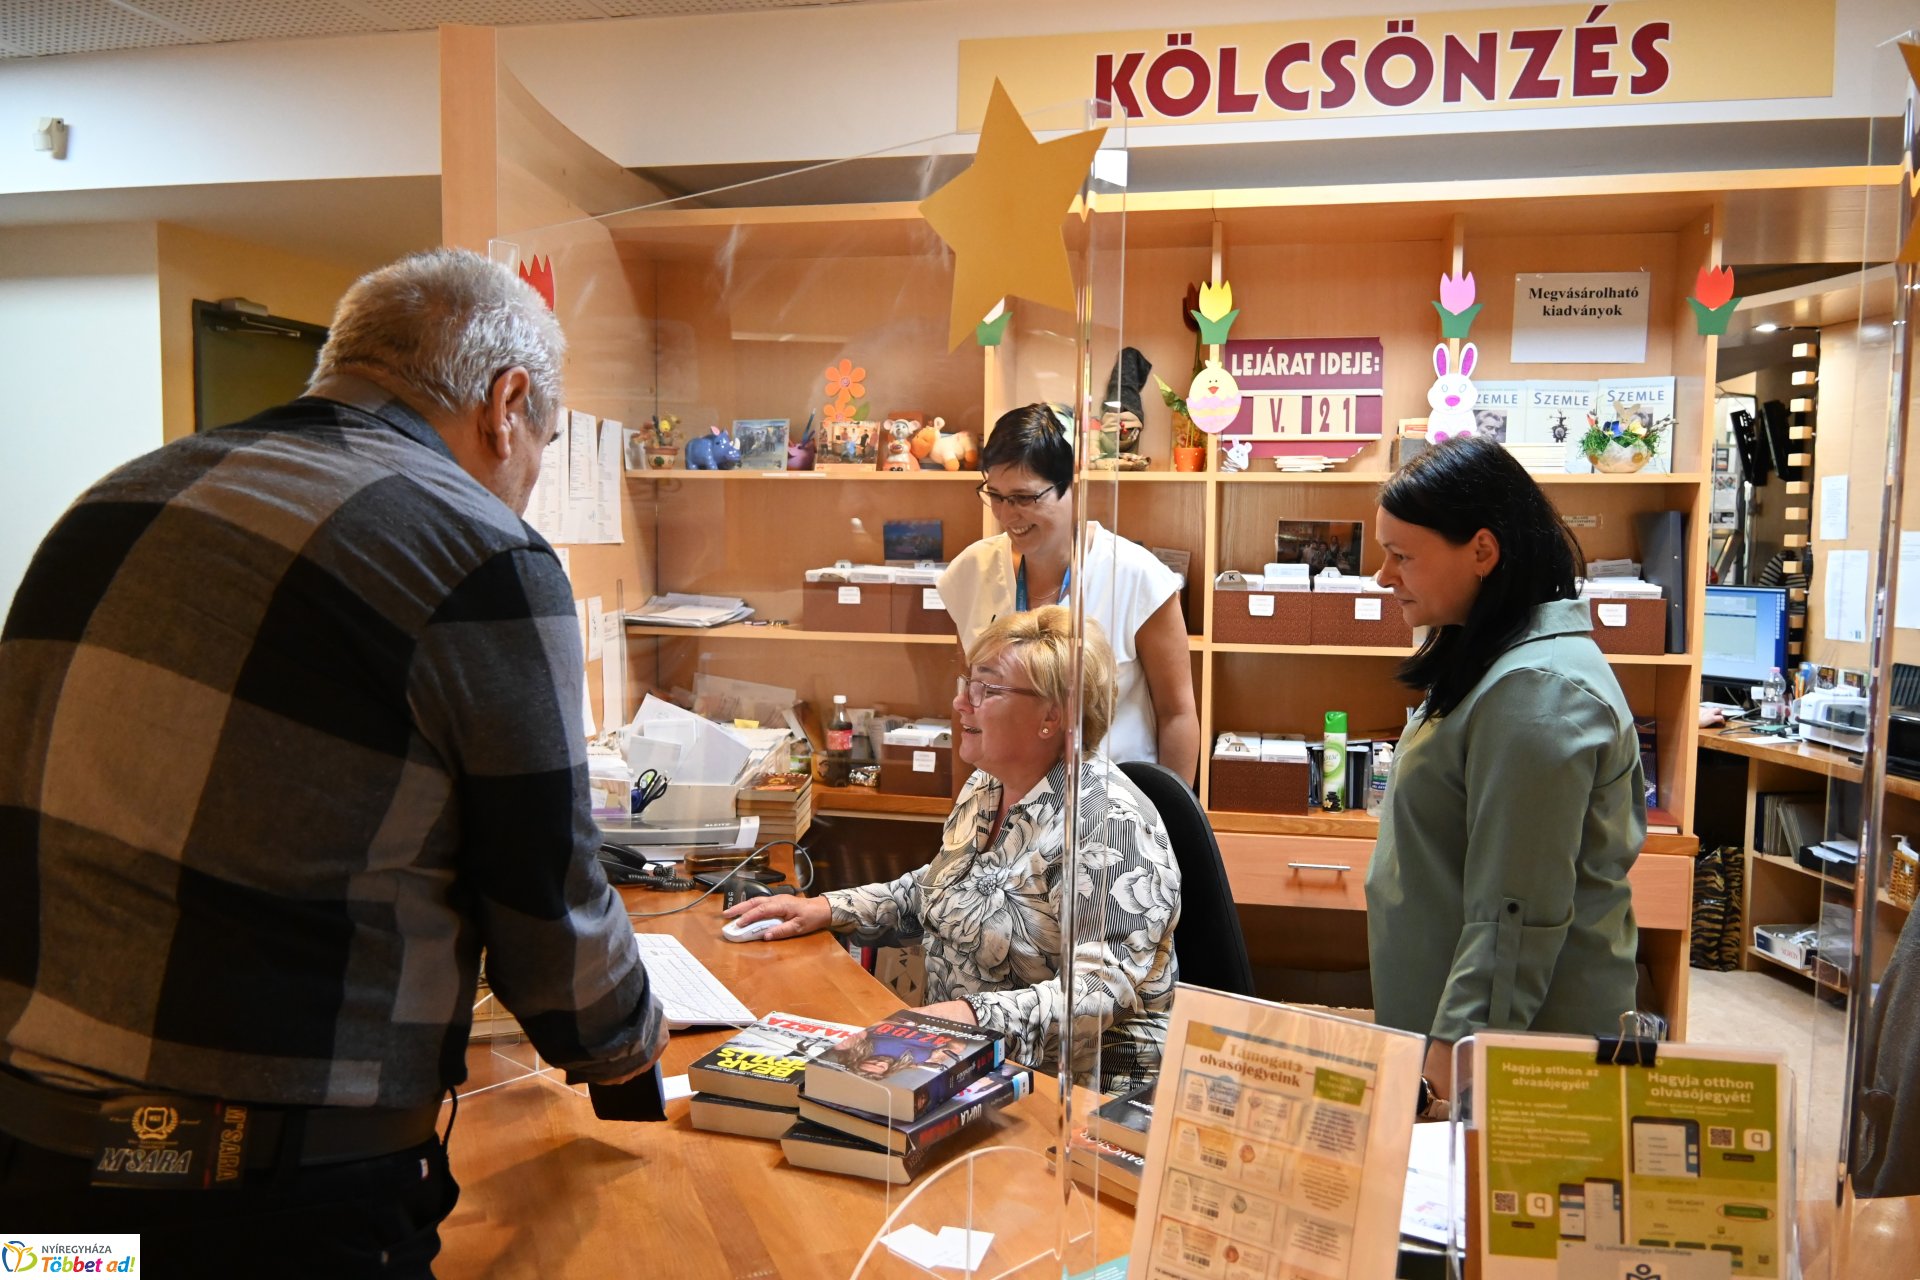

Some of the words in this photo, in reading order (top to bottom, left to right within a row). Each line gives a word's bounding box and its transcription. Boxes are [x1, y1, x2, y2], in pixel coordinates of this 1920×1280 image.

[1095, 5, 1671, 118] KÖLCSÖNZÉS
[1529, 283, 1640, 303] Megvásárolható
[1542, 302, 1624, 319] kiadványok
[1231, 347, 1315, 377] LEJÁRAT
[1319, 346, 1381, 376] IDEJE:
[1475, 393, 1518, 404] ZEMLE
[1534, 391, 1589, 406] SZEMLE
[1607, 389, 1665, 403] SZEMLE
[717, 1057, 796, 1078] BEAR
[1502, 1062, 1542, 1076] Hagyja
[1545, 1065, 1582, 1076] otthon
[1585, 1068, 1600, 1077] az
[1648, 1072, 1700, 1088] Hagyja
[1703, 1077, 1754, 1090] otthon
[1650, 1086, 1752, 1104] olvasójegyét!
